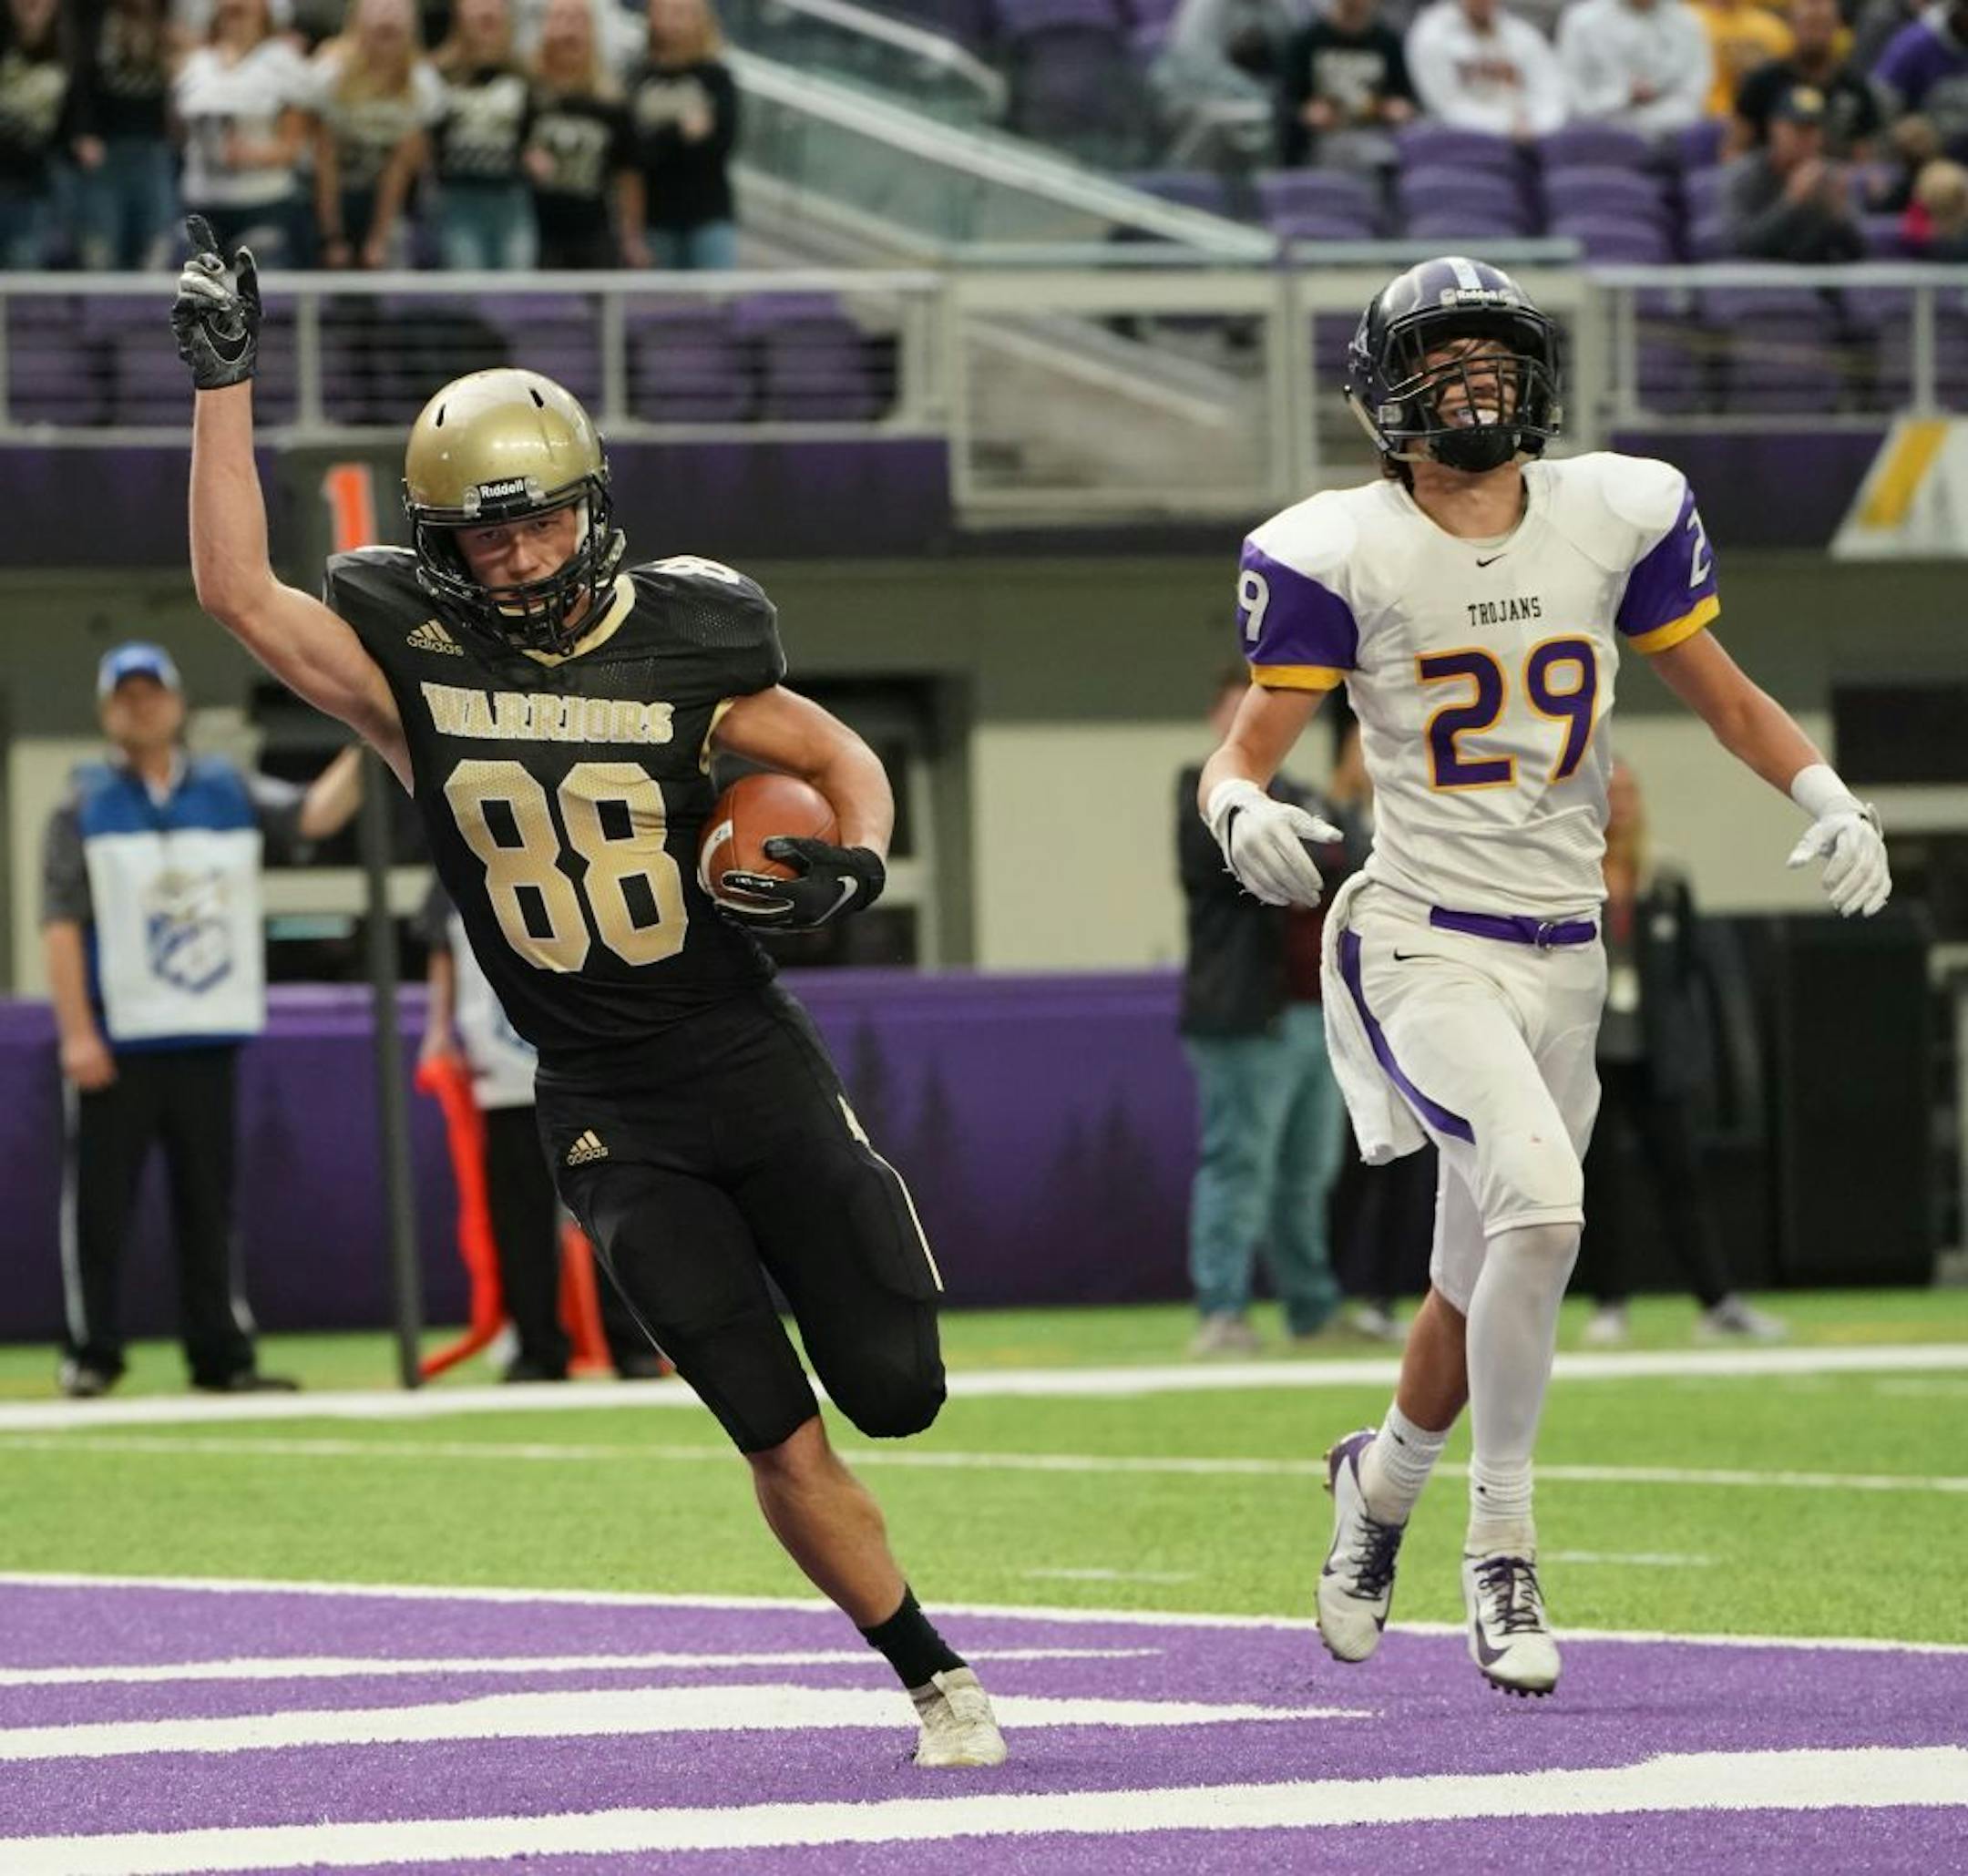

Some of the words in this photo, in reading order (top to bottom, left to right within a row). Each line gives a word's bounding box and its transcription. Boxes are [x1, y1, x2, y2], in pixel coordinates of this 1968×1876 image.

[479, 478, 525, 499] Riddell
[1467, 595, 1542, 627] TROJANS
[405, 634, 465, 657] adidas
[420, 681, 676, 744] WARRIORS
[1414, 634, 1599, 794] 29
[444, 758, 690, 974] 88
[566, 1146, 610, 1166] adidas
